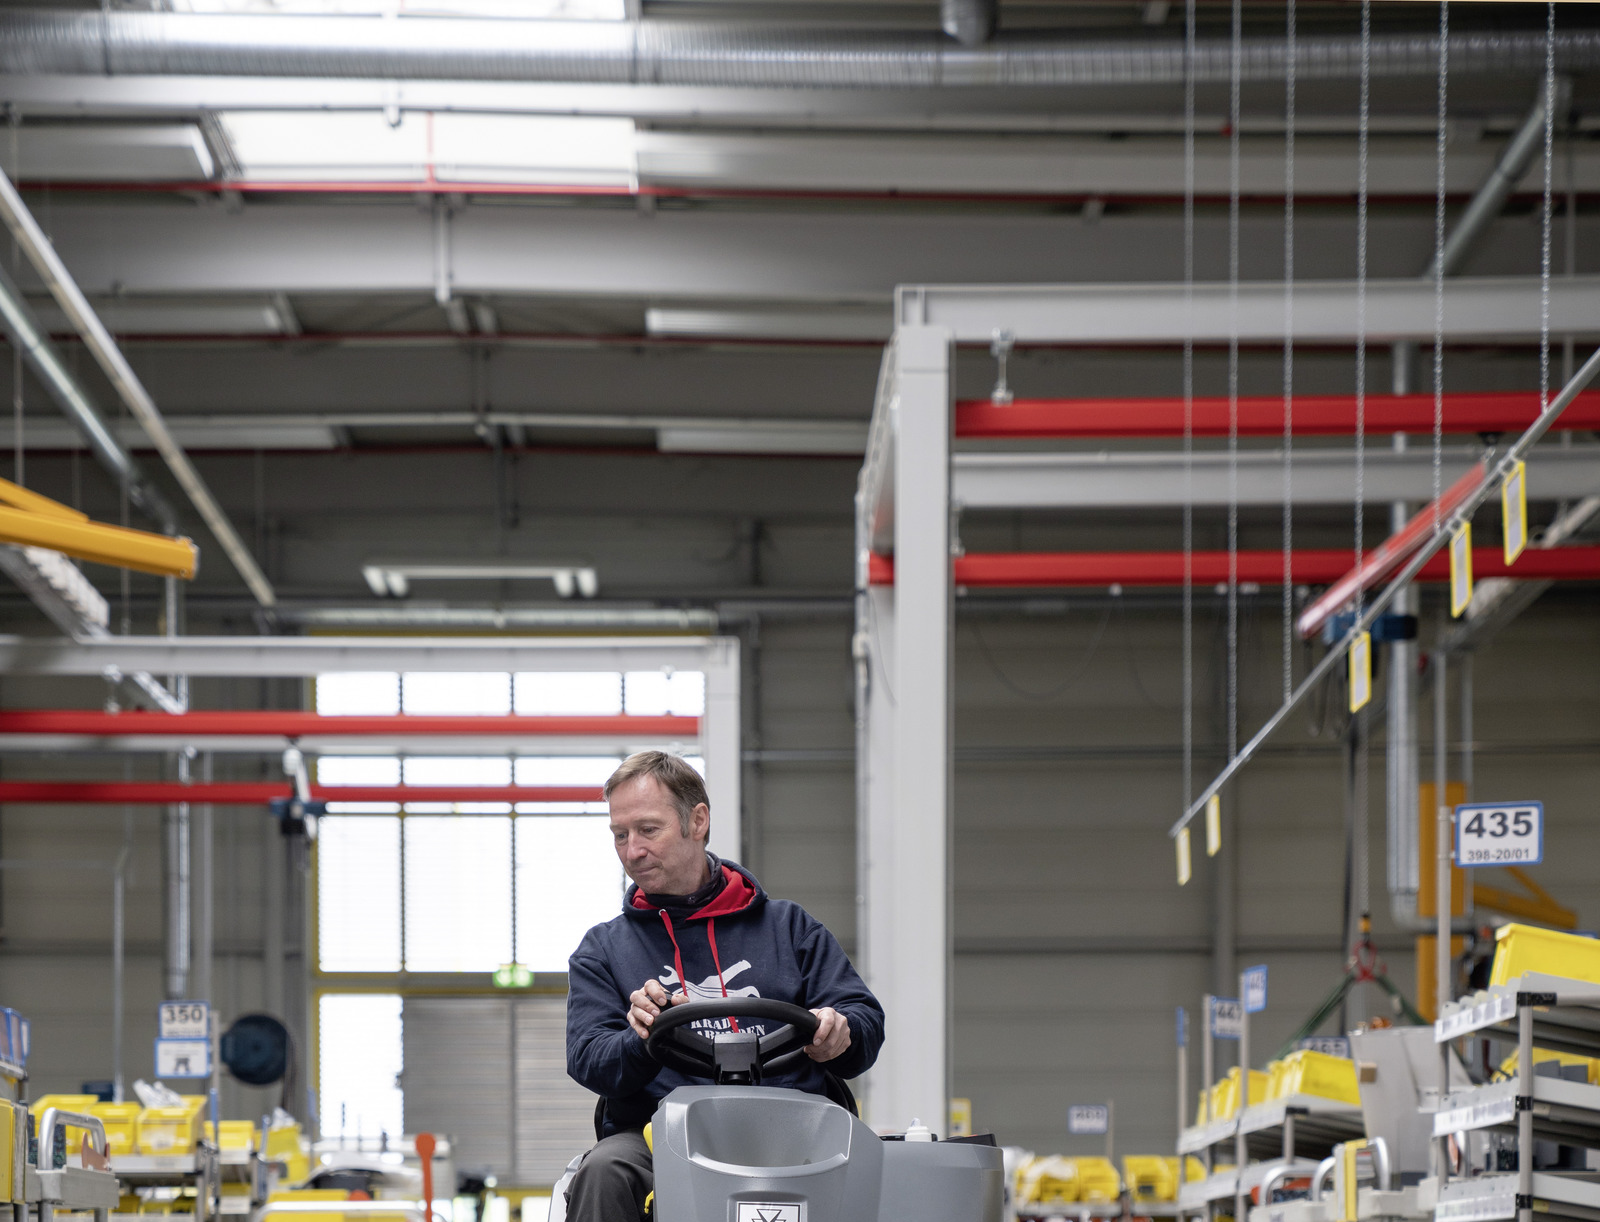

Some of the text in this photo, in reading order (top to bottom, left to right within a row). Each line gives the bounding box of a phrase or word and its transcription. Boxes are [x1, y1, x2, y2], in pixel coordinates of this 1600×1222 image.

[1464, 811, 1533, 838] 435
[1467, 848, 1529, 861] 398-20/01
[163, 1004, 203, 1024] 350
